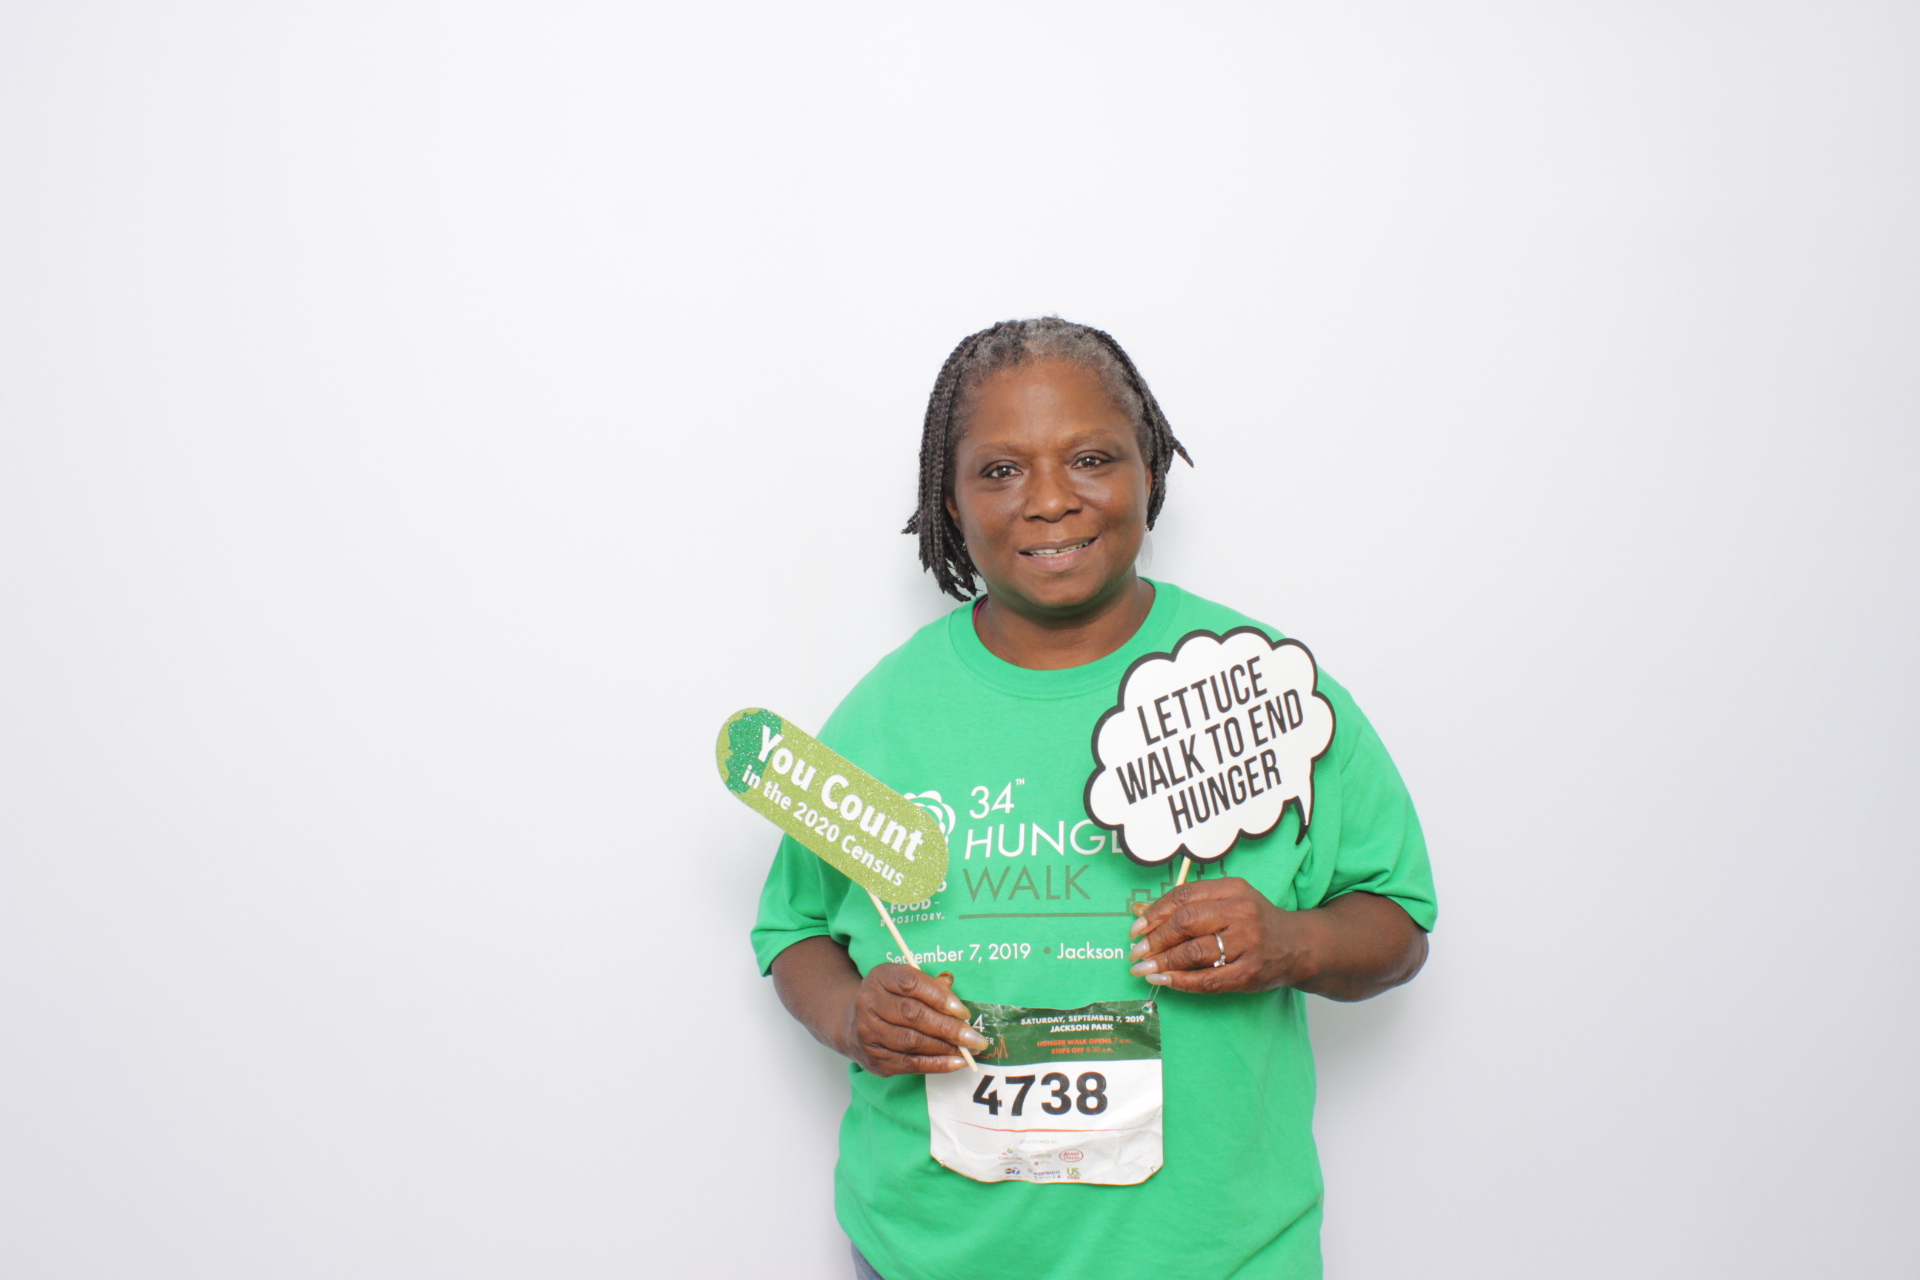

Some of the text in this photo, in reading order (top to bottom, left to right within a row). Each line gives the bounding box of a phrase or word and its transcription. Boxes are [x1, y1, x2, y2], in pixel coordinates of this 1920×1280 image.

[1137, 655, 1267, 746] LETTUCE
[1116, 688, 1304, 805] WALK TO END
[756, 725, 925, 861] You Count
[1167, 749, 1282, 835] HUNGER
[741, 764, 905, 887] in the 2020 Census
[964, 819, 1123, 860] HUNG
[963, 865, 1091, 903] WALK
[880, 912, 943, 927] DPOSITORY
[969, 944, 982, 963] 7,
[988, 943, 1032, 960] 2019
[1057, 941, 1124, 960] Jackson
[1021, 1016, 1066, 1026] SATURDAY,
[1068, 1014, 1114, 1023] SEPTEMBER
[1125, 1015, 1145, 1023] 2019
[1050, 1023, 1114, 1033] JACKSON PARK
[1037, 1039, 1067, 1047] HUNGER
[972, 1071, 1108, 1116] 4738
